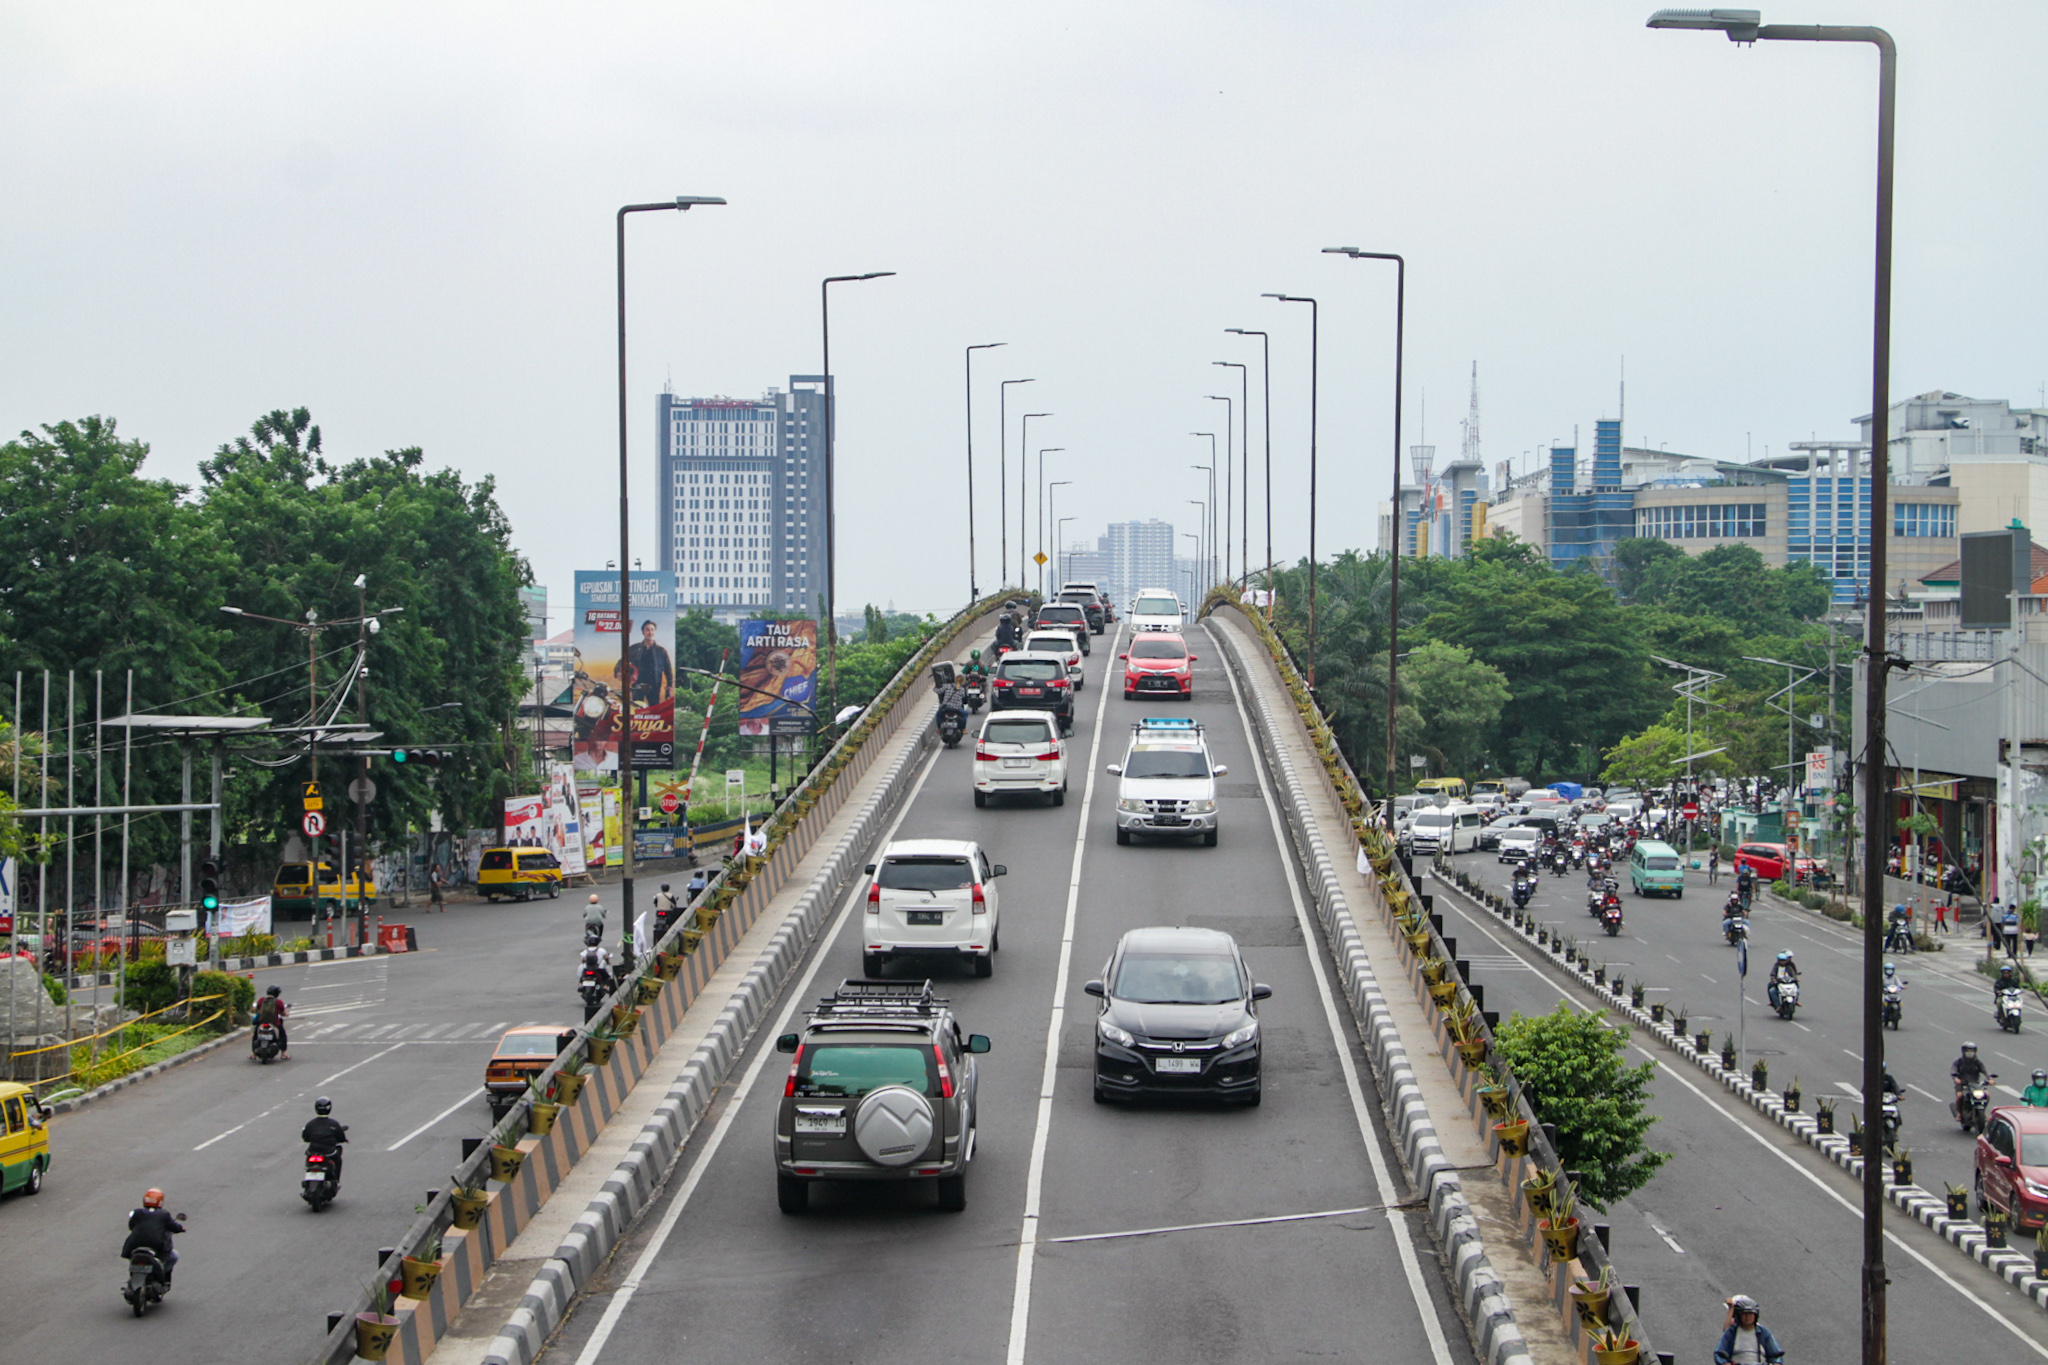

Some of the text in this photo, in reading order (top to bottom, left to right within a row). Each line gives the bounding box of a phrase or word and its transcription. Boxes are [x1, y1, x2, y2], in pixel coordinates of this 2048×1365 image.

[580, 581, 613, 594] KEPUASAN
[628, 593, 669, 608] ENIKMATI
[588, 612, 597, 621] 16
[766, 624, 791, 635] TAU
[746, 636, 811, 647] ARTI RASA
[783, 681, 809, 698] CHIEF
[1812, 772, 1826, 780] BNI
[661, 798, 677, 807] STOP
[808, 1117, 829, 1127] 1949
